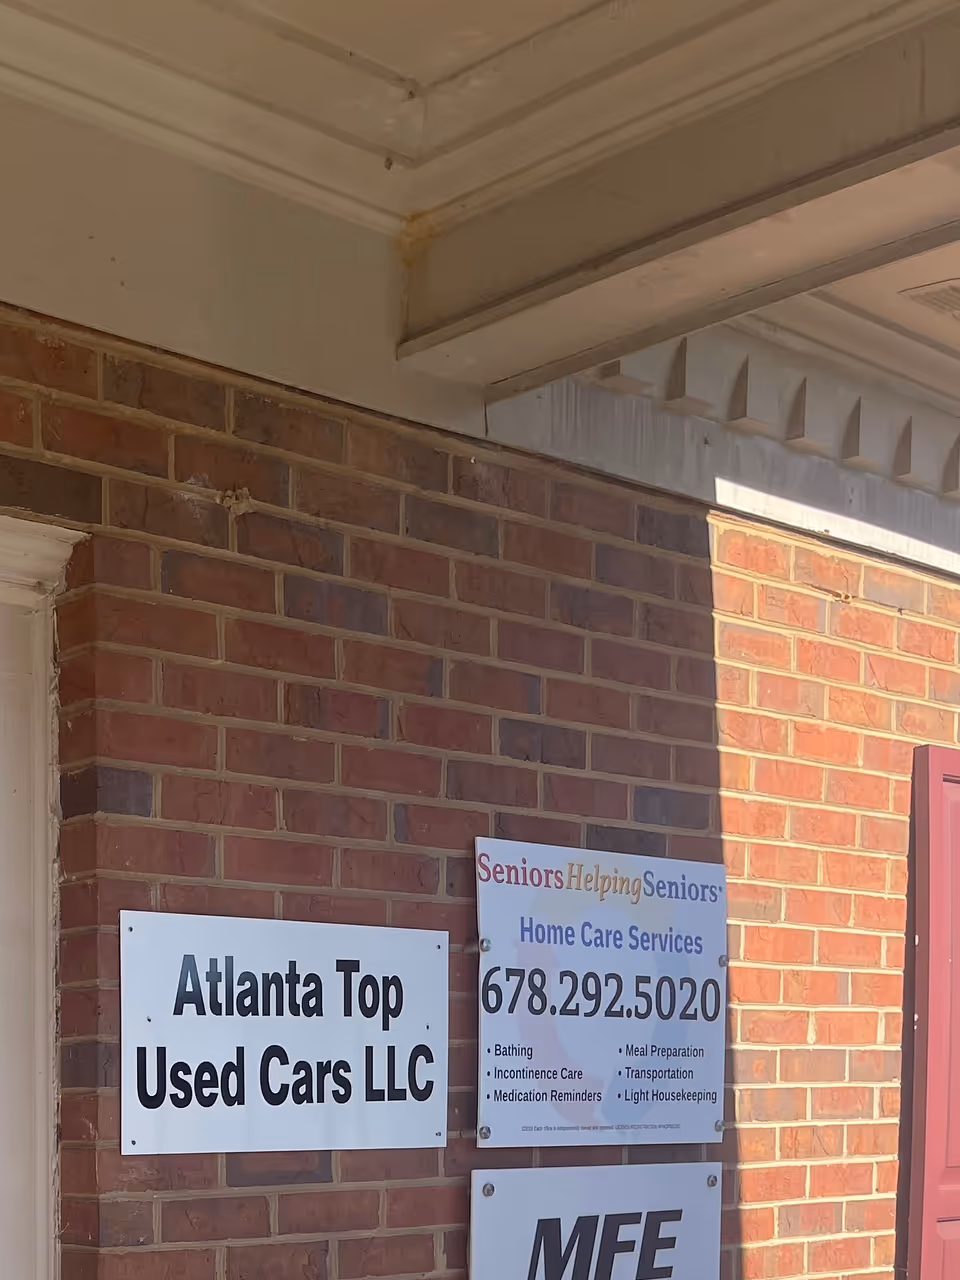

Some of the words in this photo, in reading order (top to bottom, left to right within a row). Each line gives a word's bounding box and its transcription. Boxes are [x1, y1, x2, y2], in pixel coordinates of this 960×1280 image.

[520, 916, 575, 946] Home
[580, 921, 623, 949] Care
[628, 925, 703, 955] Services
[172, 954, 324, 1018] Atlanta
[335, 959, 404, 1031] Top
[481, 966, 721, 1022] 678.292.5020
[494, 1044, 533, 1060] Bathing
[625, 1044, 648, 1057] Meal
[650, 1045, 704, 1058] Preparation
[136, 1046, 245, 1109] Used
[259, 1044, 352, 1106] Cars
[364, 1043, 435, 1102] LLC
[494, 1067, 558, 1080] Incontinence
[560, 1067, 583, 1080] Care
[625, 1066, 694, 1083] Transportation
[493, 1090, 548, 1103] Medication
[550, 1089, 602, 1103] Reminders
[624, 1089, 649, 1104] Light
[651, 1089, 717, 1105] Housekeeping
